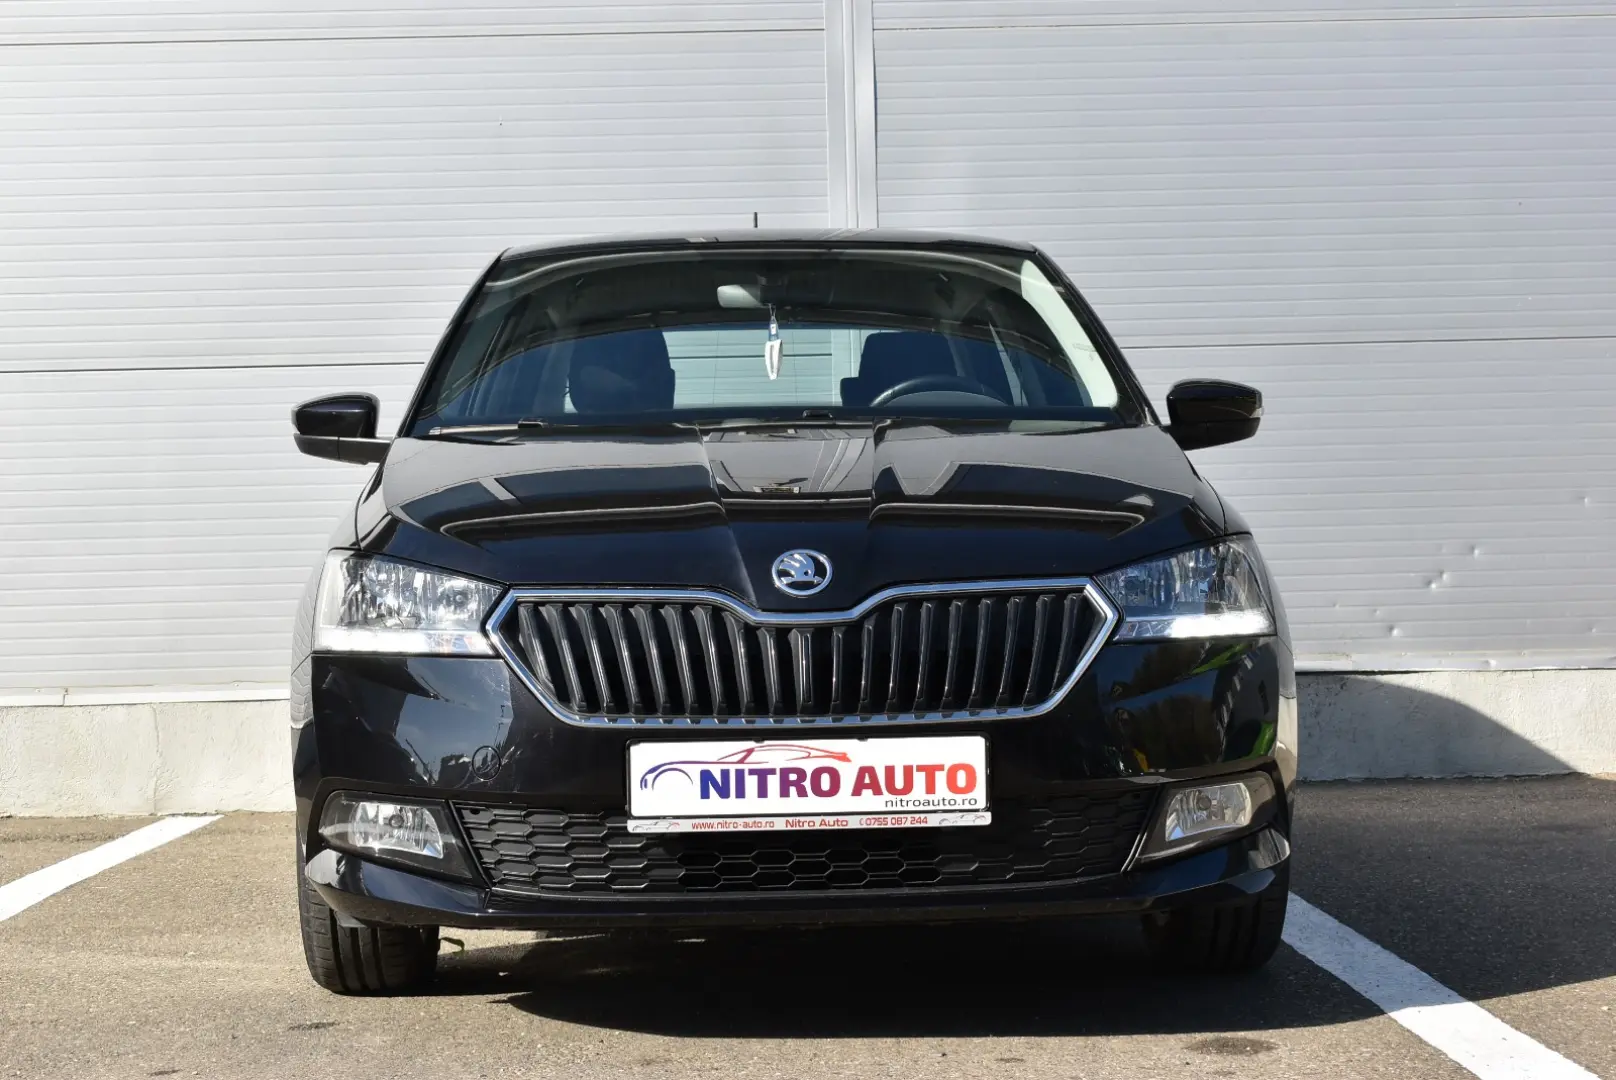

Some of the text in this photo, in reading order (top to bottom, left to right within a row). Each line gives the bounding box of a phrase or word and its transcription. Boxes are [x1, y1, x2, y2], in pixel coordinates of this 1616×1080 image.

[700, 763, 977, 800] NITRO AUTO
[885, 797, 978, 808] nitroauto.ro
[691, 815, 928, 830] www.nitro-auto.ro Nitro Auto 0755 087 244
